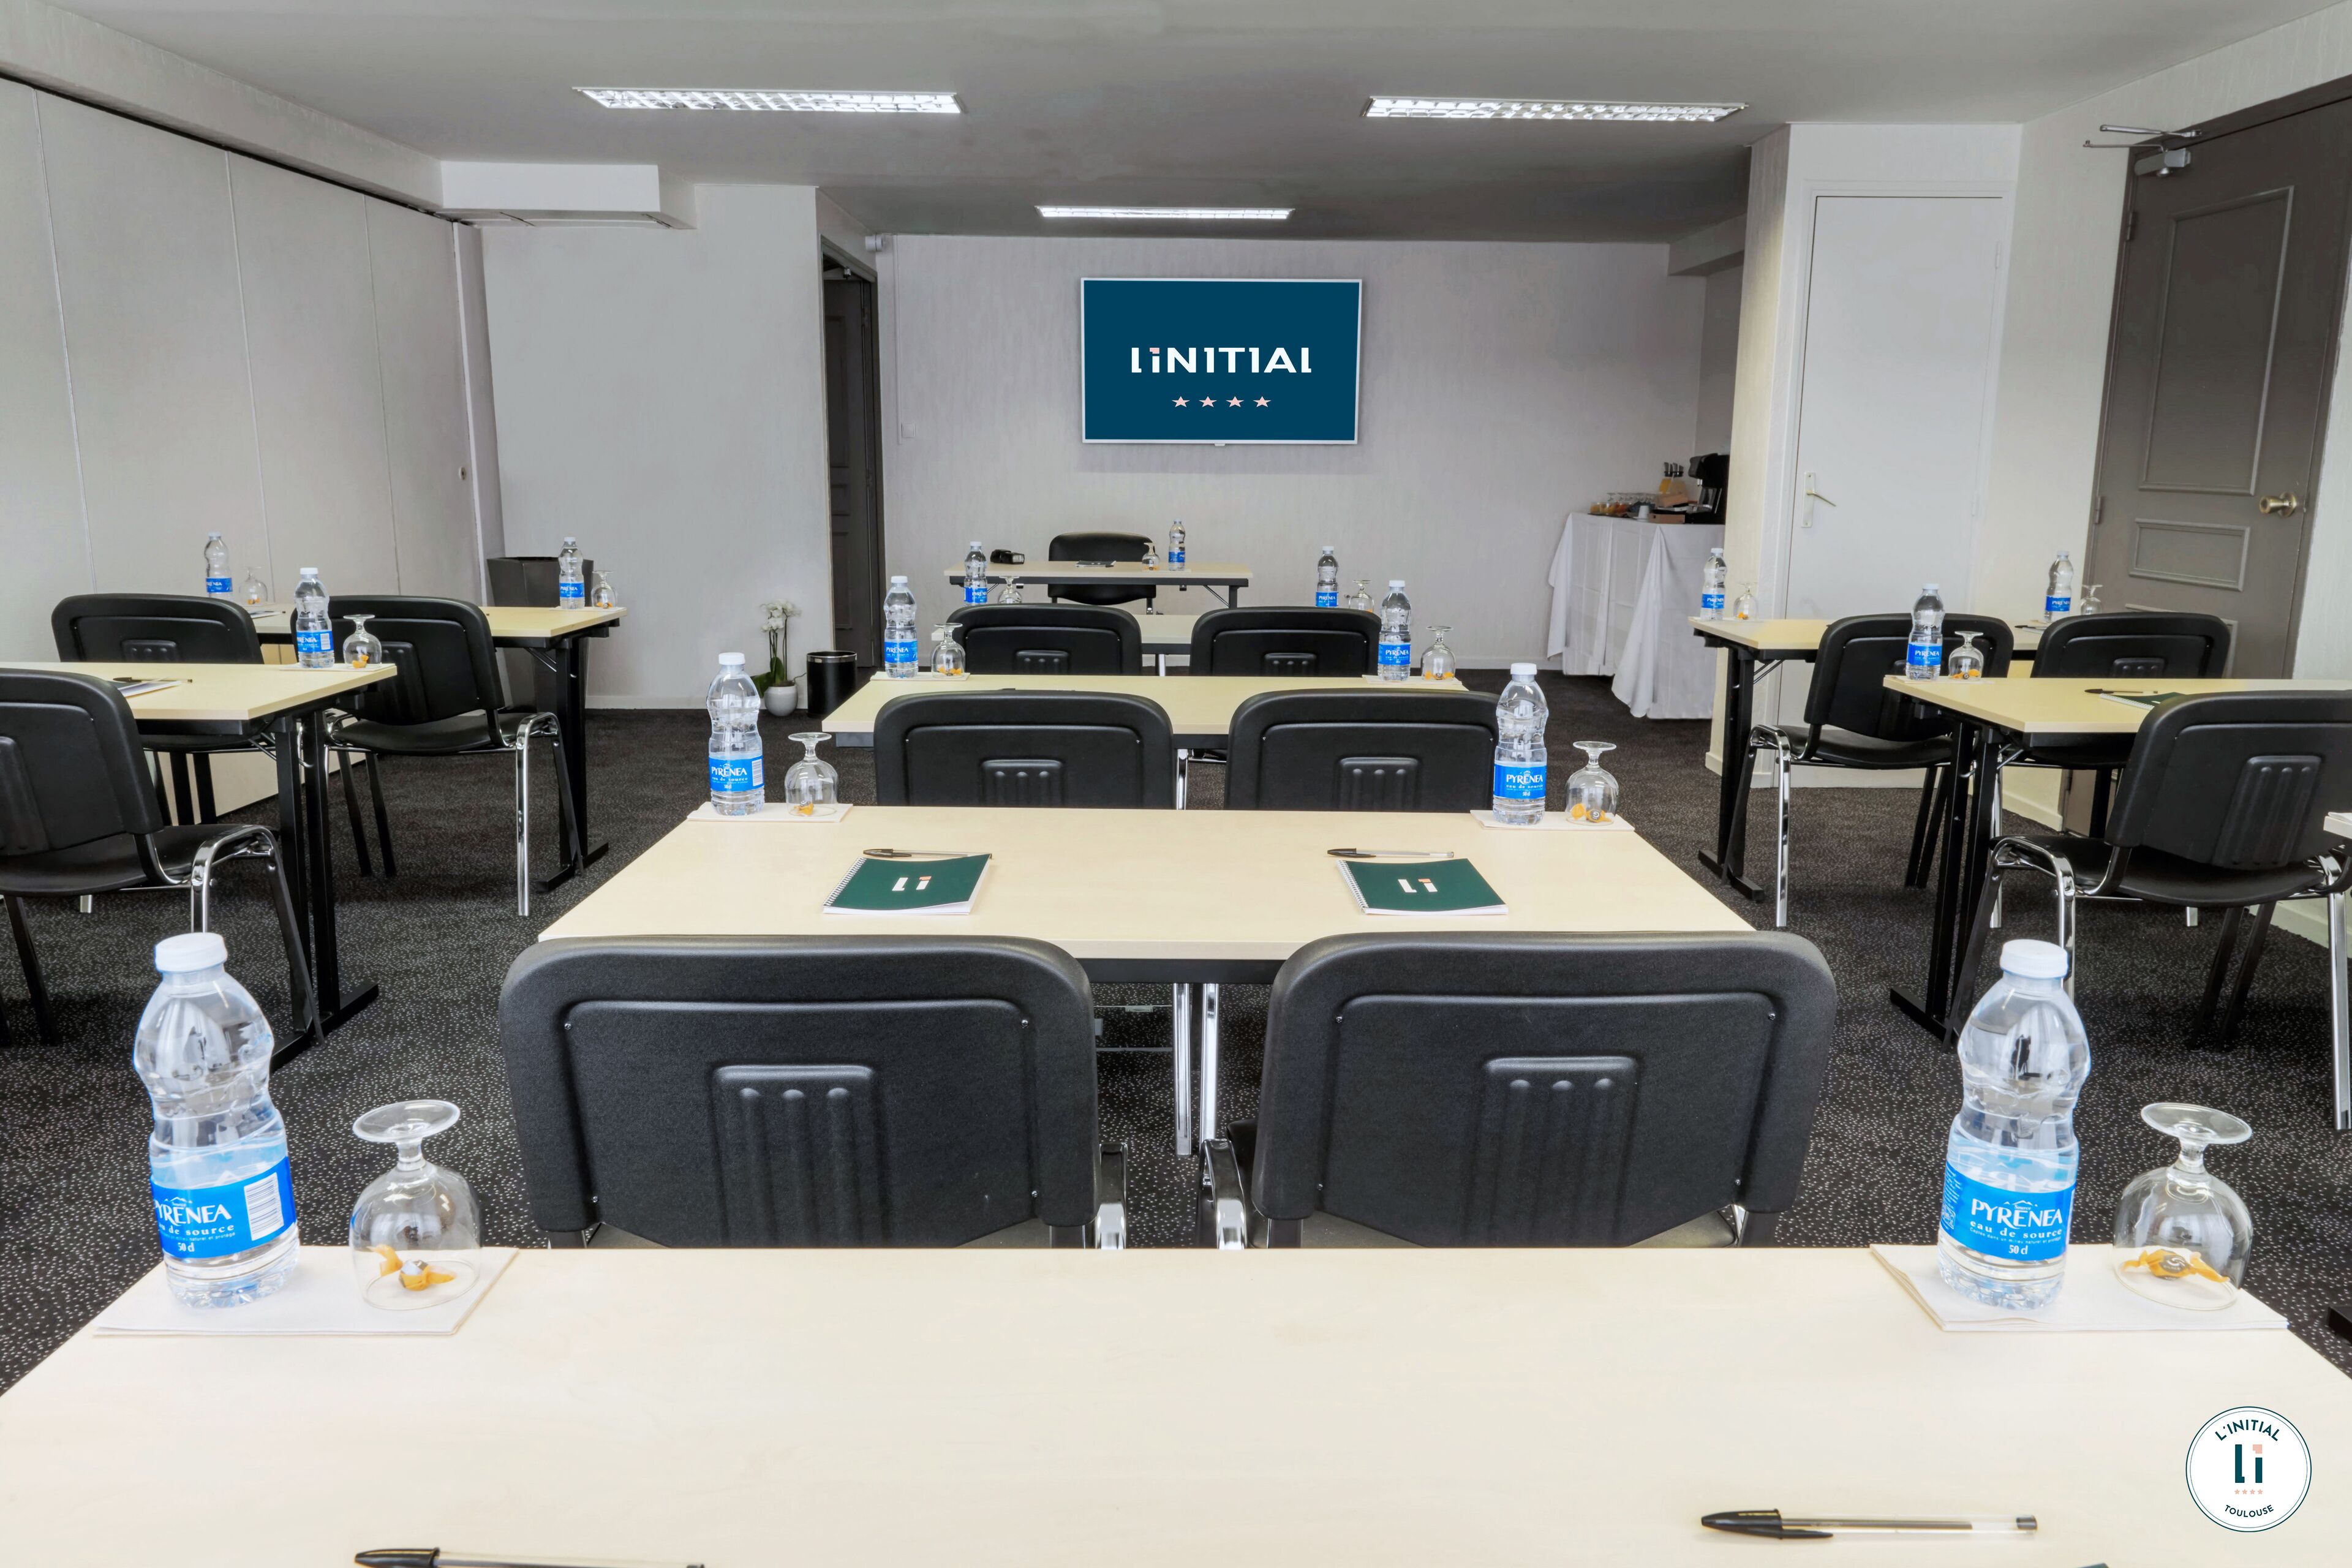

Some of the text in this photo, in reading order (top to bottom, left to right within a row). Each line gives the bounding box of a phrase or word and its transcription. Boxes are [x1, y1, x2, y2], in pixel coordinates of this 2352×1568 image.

[711, 766, 747, 777] PYRENEA
[1506, 774, 1544, 785] PYRENEA
[1971, 1197, 2063, 1230] PYRENEA
[168, 1225, 179, 1235] de
[186, 1224, 235, 1236] source
[1970, 1221, 2062, 1239] eau de source
[177, 1242, 186, 1251] 50
[2008, 1244, 2019, 1254] 50
